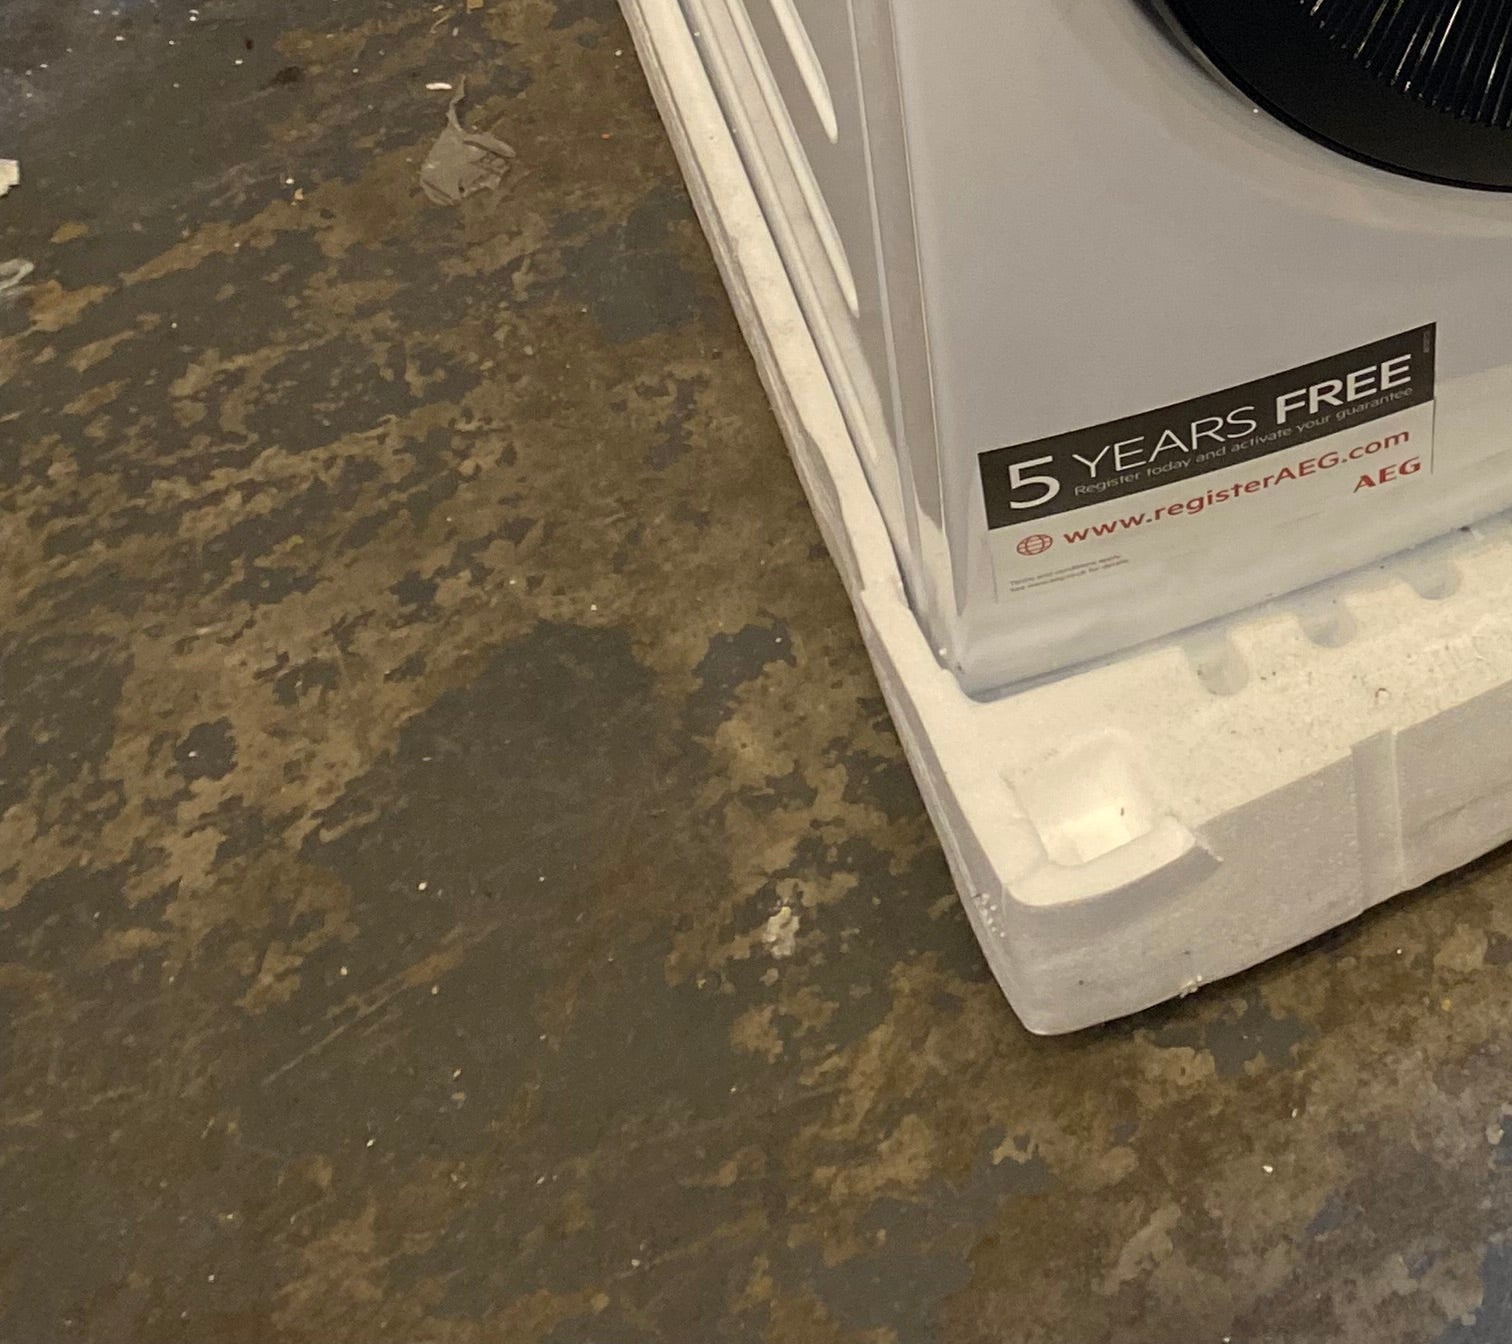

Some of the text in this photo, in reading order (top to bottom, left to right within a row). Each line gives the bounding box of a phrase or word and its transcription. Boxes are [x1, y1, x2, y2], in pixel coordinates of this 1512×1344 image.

[1008, 353, 1412, 509] 5 YEARS FREE
[1074, 386, 1413, 496] Register today and activate your guarantee
[1353, 456, 1422, 493] AEG
[1063, 431, 1410, 544] www.registerAEG.com
